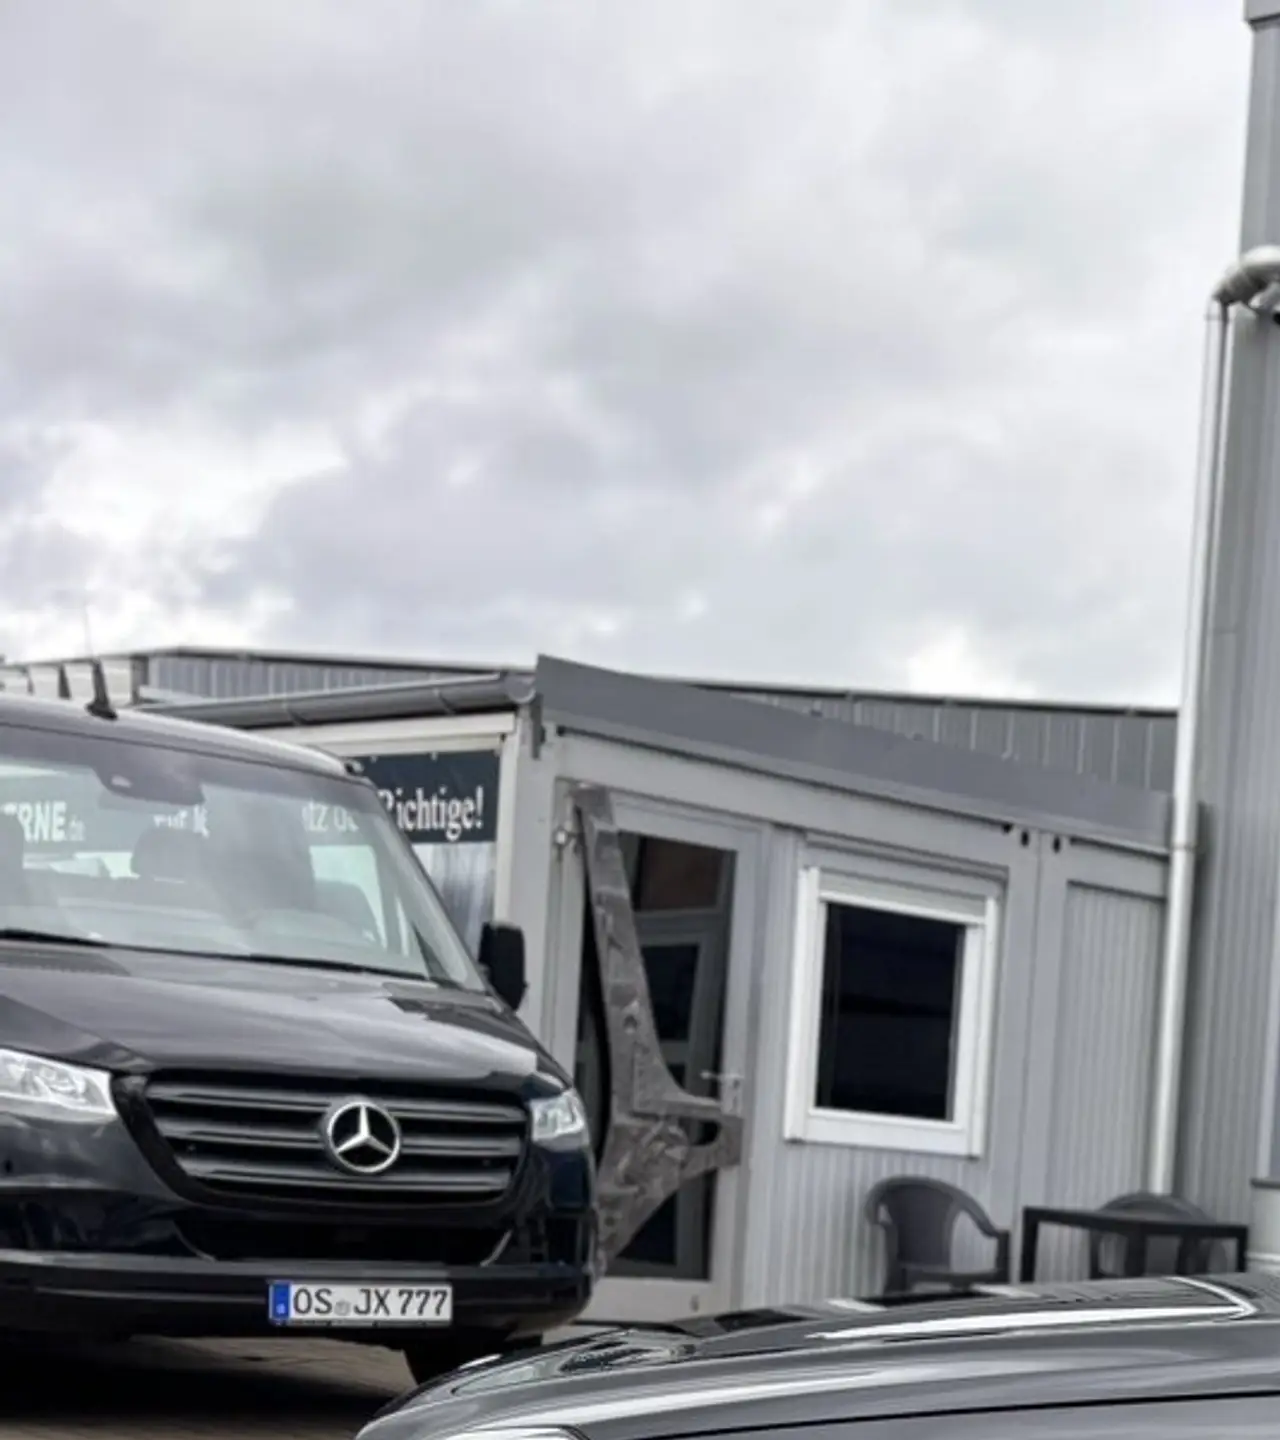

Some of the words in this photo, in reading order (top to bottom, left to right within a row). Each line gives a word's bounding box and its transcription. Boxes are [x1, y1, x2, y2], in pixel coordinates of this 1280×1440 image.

[293, 1288, 333, 1315] OS
[354, 1288, 391, 1316] JX
[398, 1288, 448, 1316] 777
